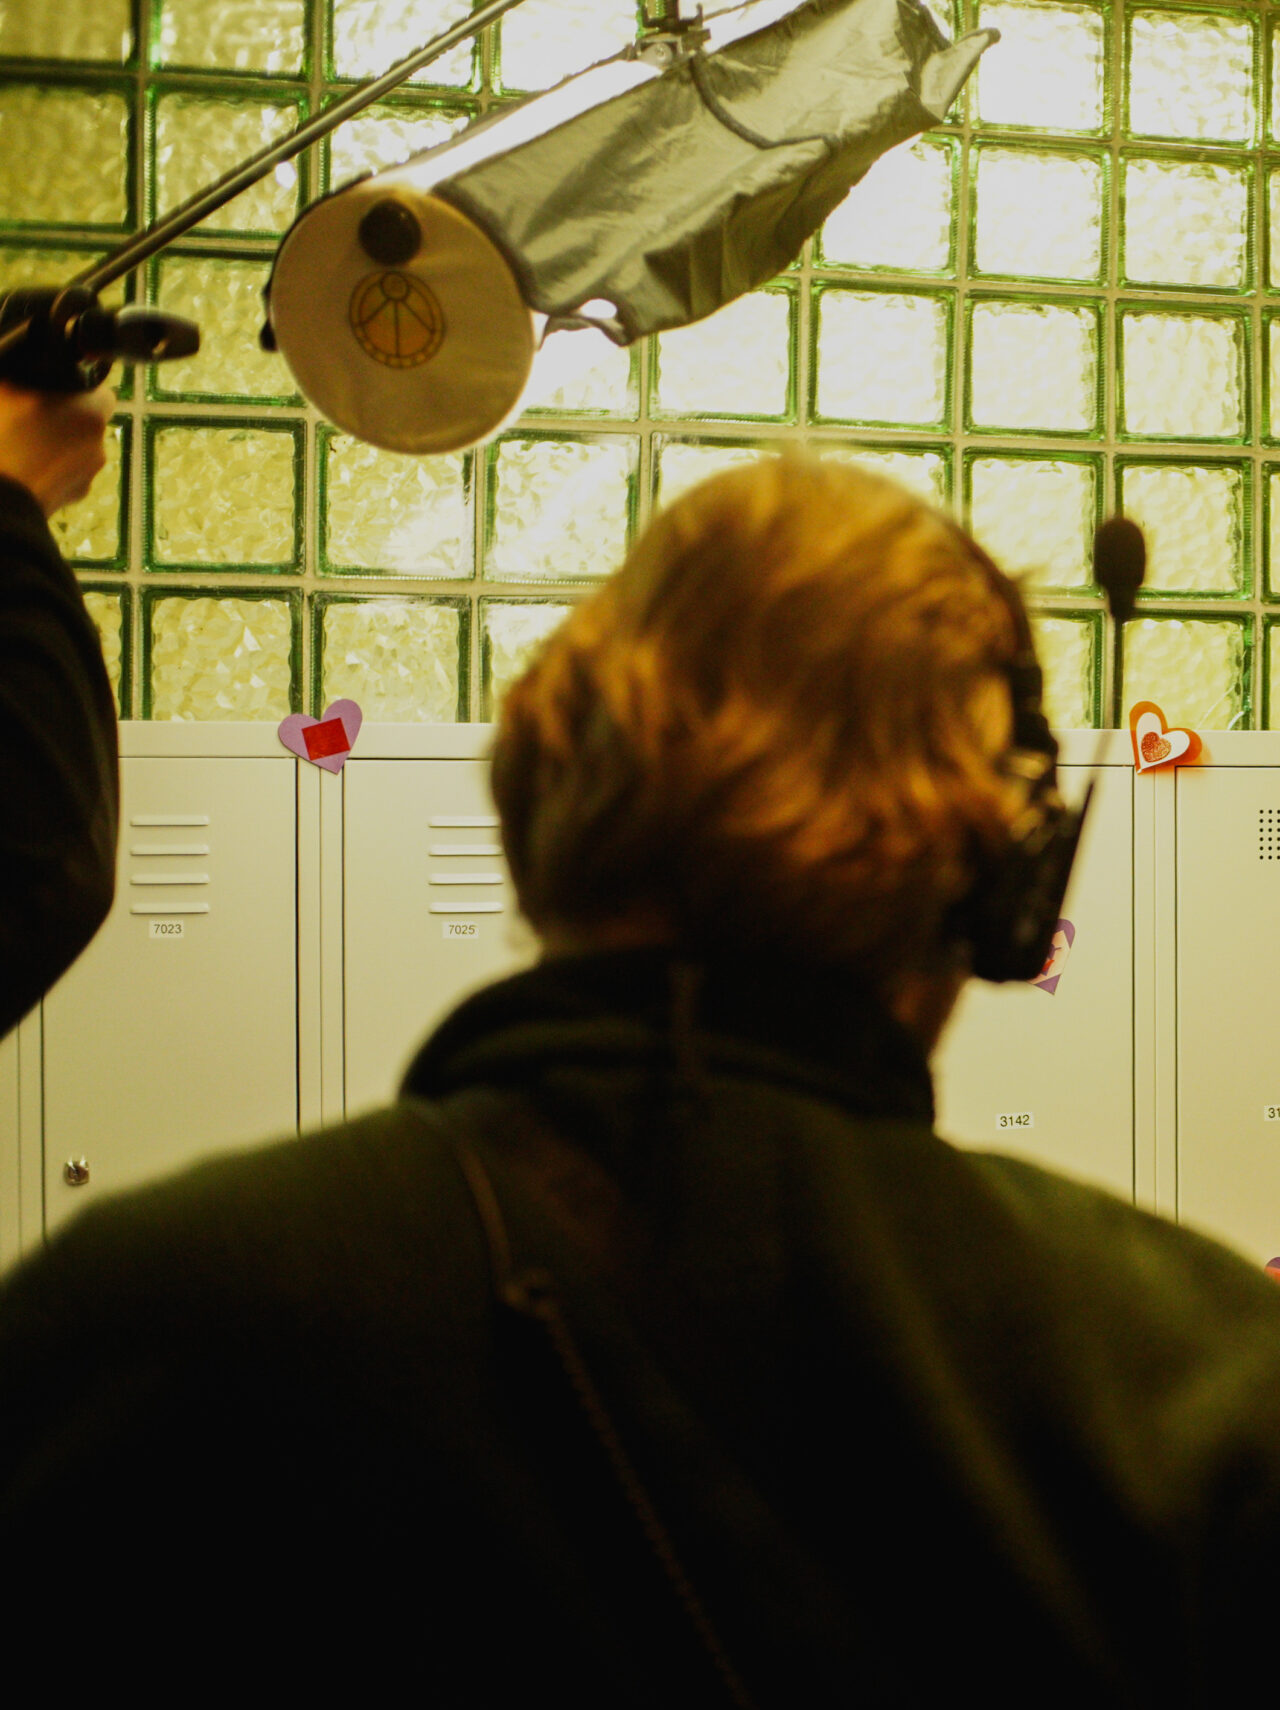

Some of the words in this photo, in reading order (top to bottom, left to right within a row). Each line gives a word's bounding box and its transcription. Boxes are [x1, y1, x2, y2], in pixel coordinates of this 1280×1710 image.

[153, 923, 182, 934] 7023
[448, 924, 477, 935] 7025
[1000, 1114, 1030, 1127] 3142
